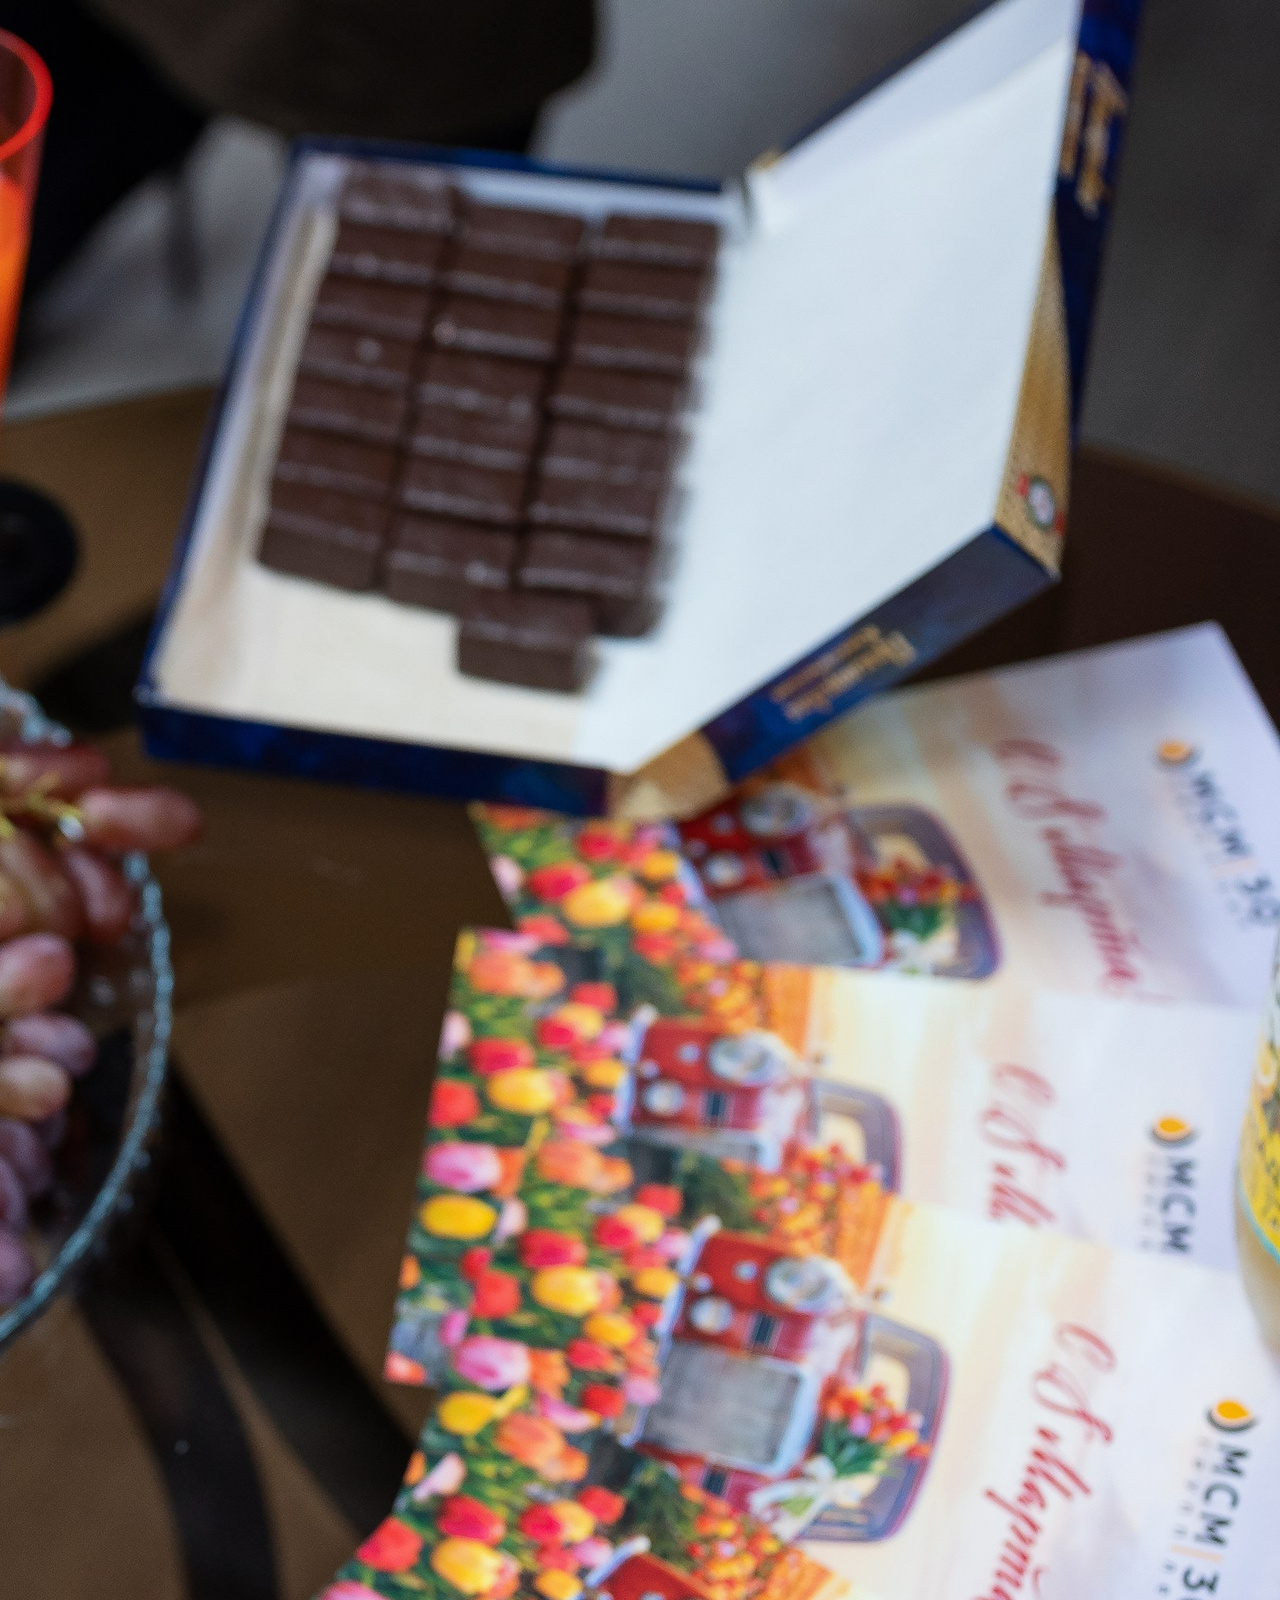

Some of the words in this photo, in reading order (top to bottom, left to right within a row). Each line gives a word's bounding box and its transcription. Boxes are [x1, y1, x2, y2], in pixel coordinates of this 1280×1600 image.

[1055, 1322, 1118, 1372] С
[1032, 1360, 1113, 1445] 8
[1193, 1444, 1250, 1547] МСМ
